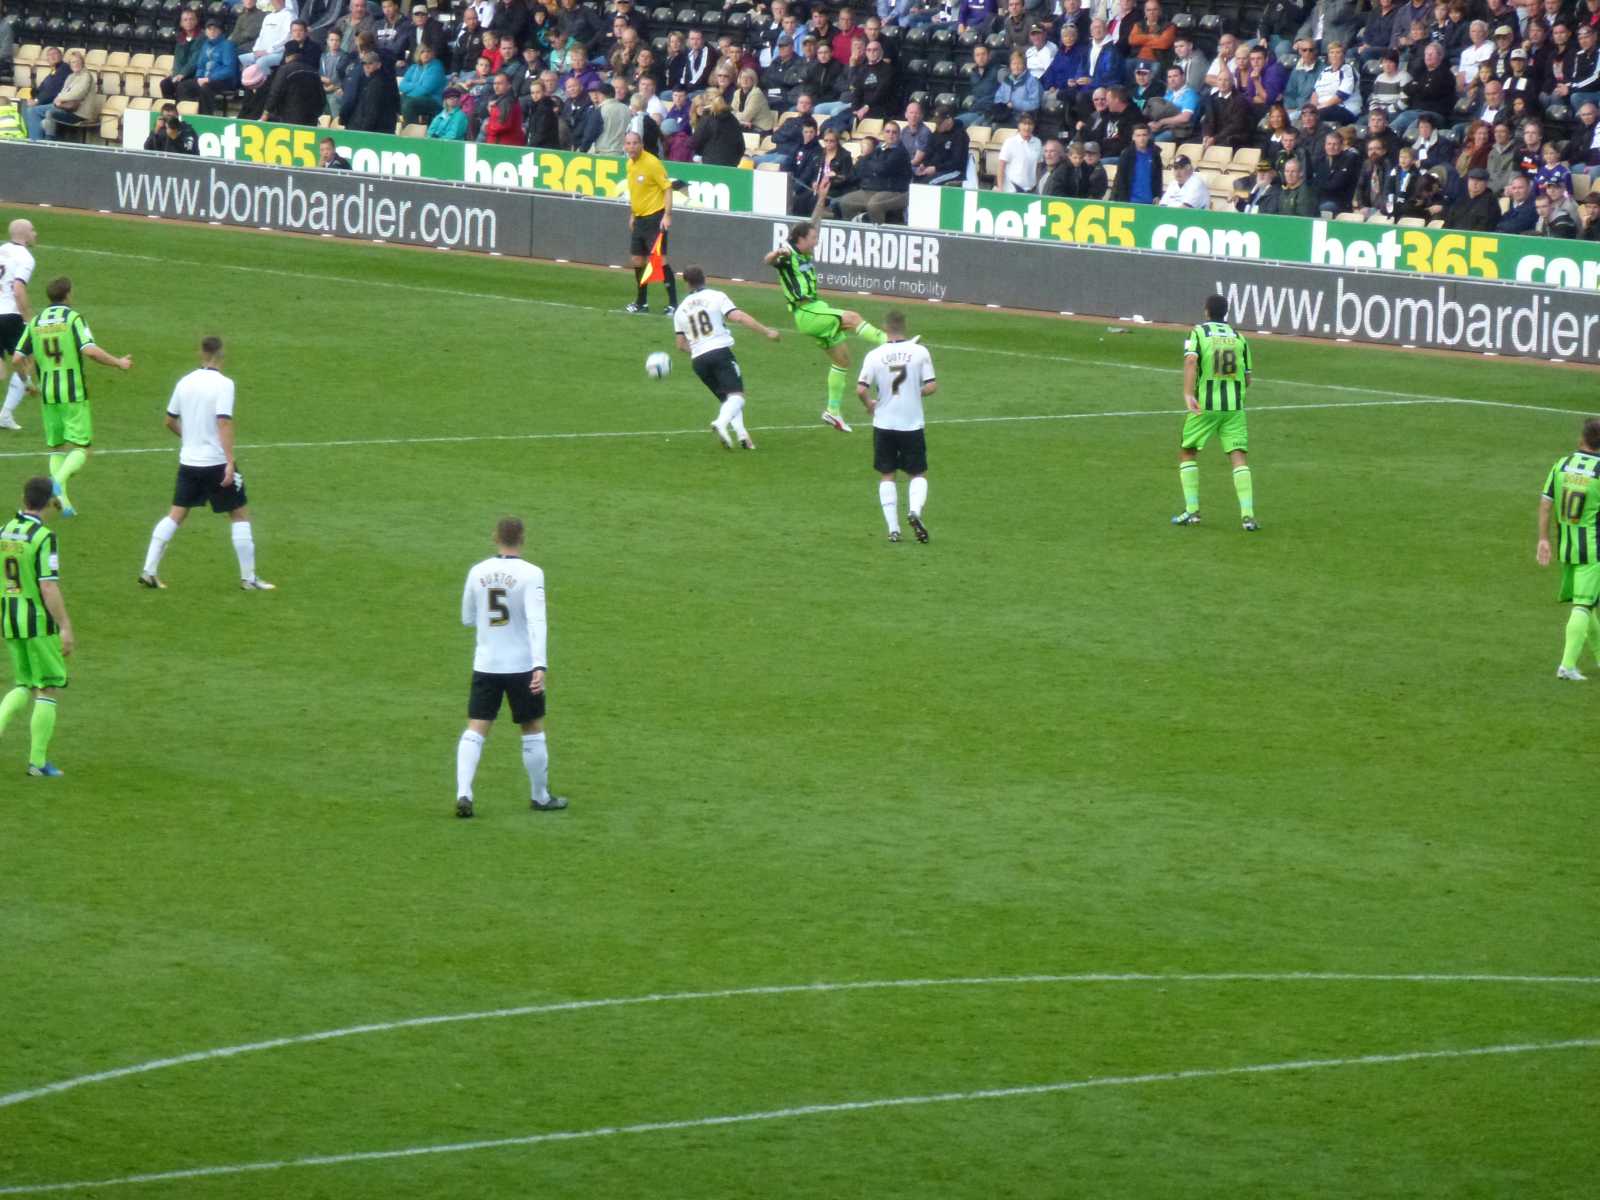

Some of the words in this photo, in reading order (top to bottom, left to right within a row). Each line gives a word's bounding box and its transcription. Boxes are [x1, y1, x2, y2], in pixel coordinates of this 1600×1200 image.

[198, 123, 317, 168] et365
[116, 167, 497, 249] www.bombardier.com
[772, 222, 941, 275] BMBARDIER
[827, 273, 881, 289] evolution
[884, 275, 896, 290] of
[900, 279, 947, 297] mobility
[687, 308, 714, 341] 18
[42, 336, 64, 366] 4
[1213, 348, 1238, 377] 18
[888, 364, 908, 396] 7
[1560, 486, 1587, 522] 10
[4, 555, 22, 593] 9
[486, 587, 511, 627] 5
